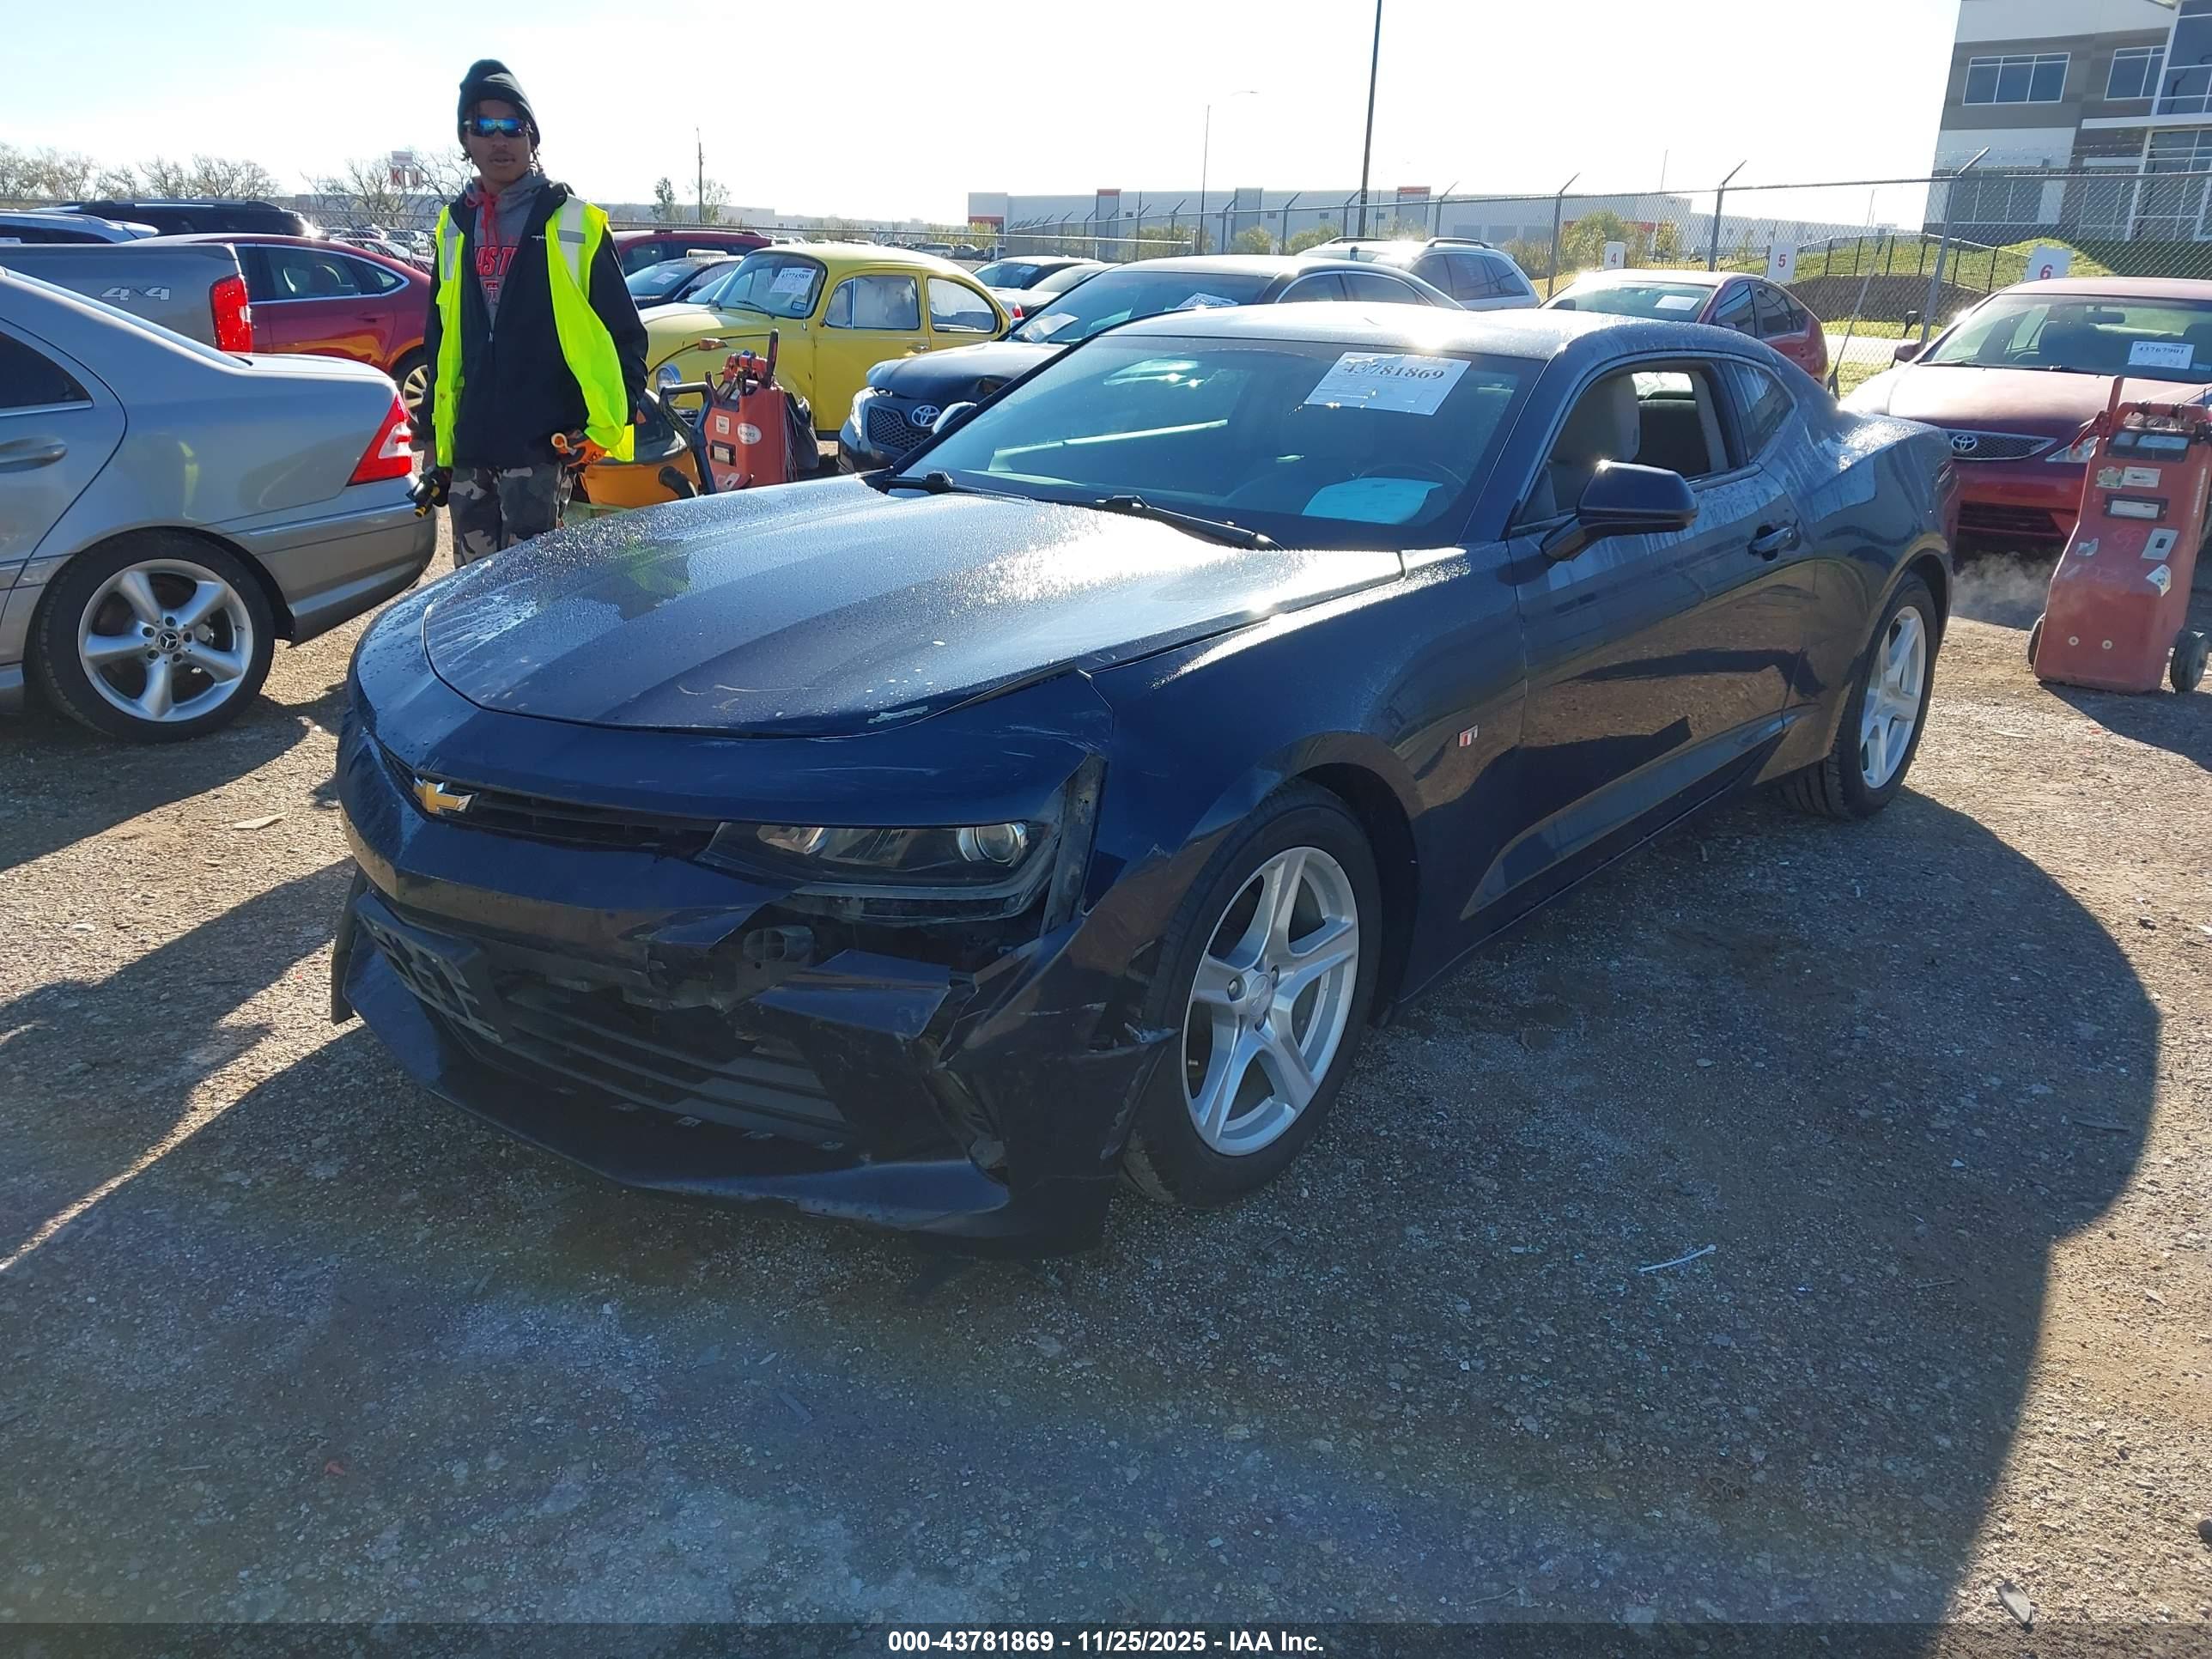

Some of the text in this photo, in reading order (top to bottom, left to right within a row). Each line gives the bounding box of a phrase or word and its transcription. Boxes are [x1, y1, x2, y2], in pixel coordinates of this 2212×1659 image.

[392, 168, 402, 185] K
[1610, 252, 1618, 265] 4
[1778, 254, 1787, 268] 5
[2040, 264, 2053, 279] 6
